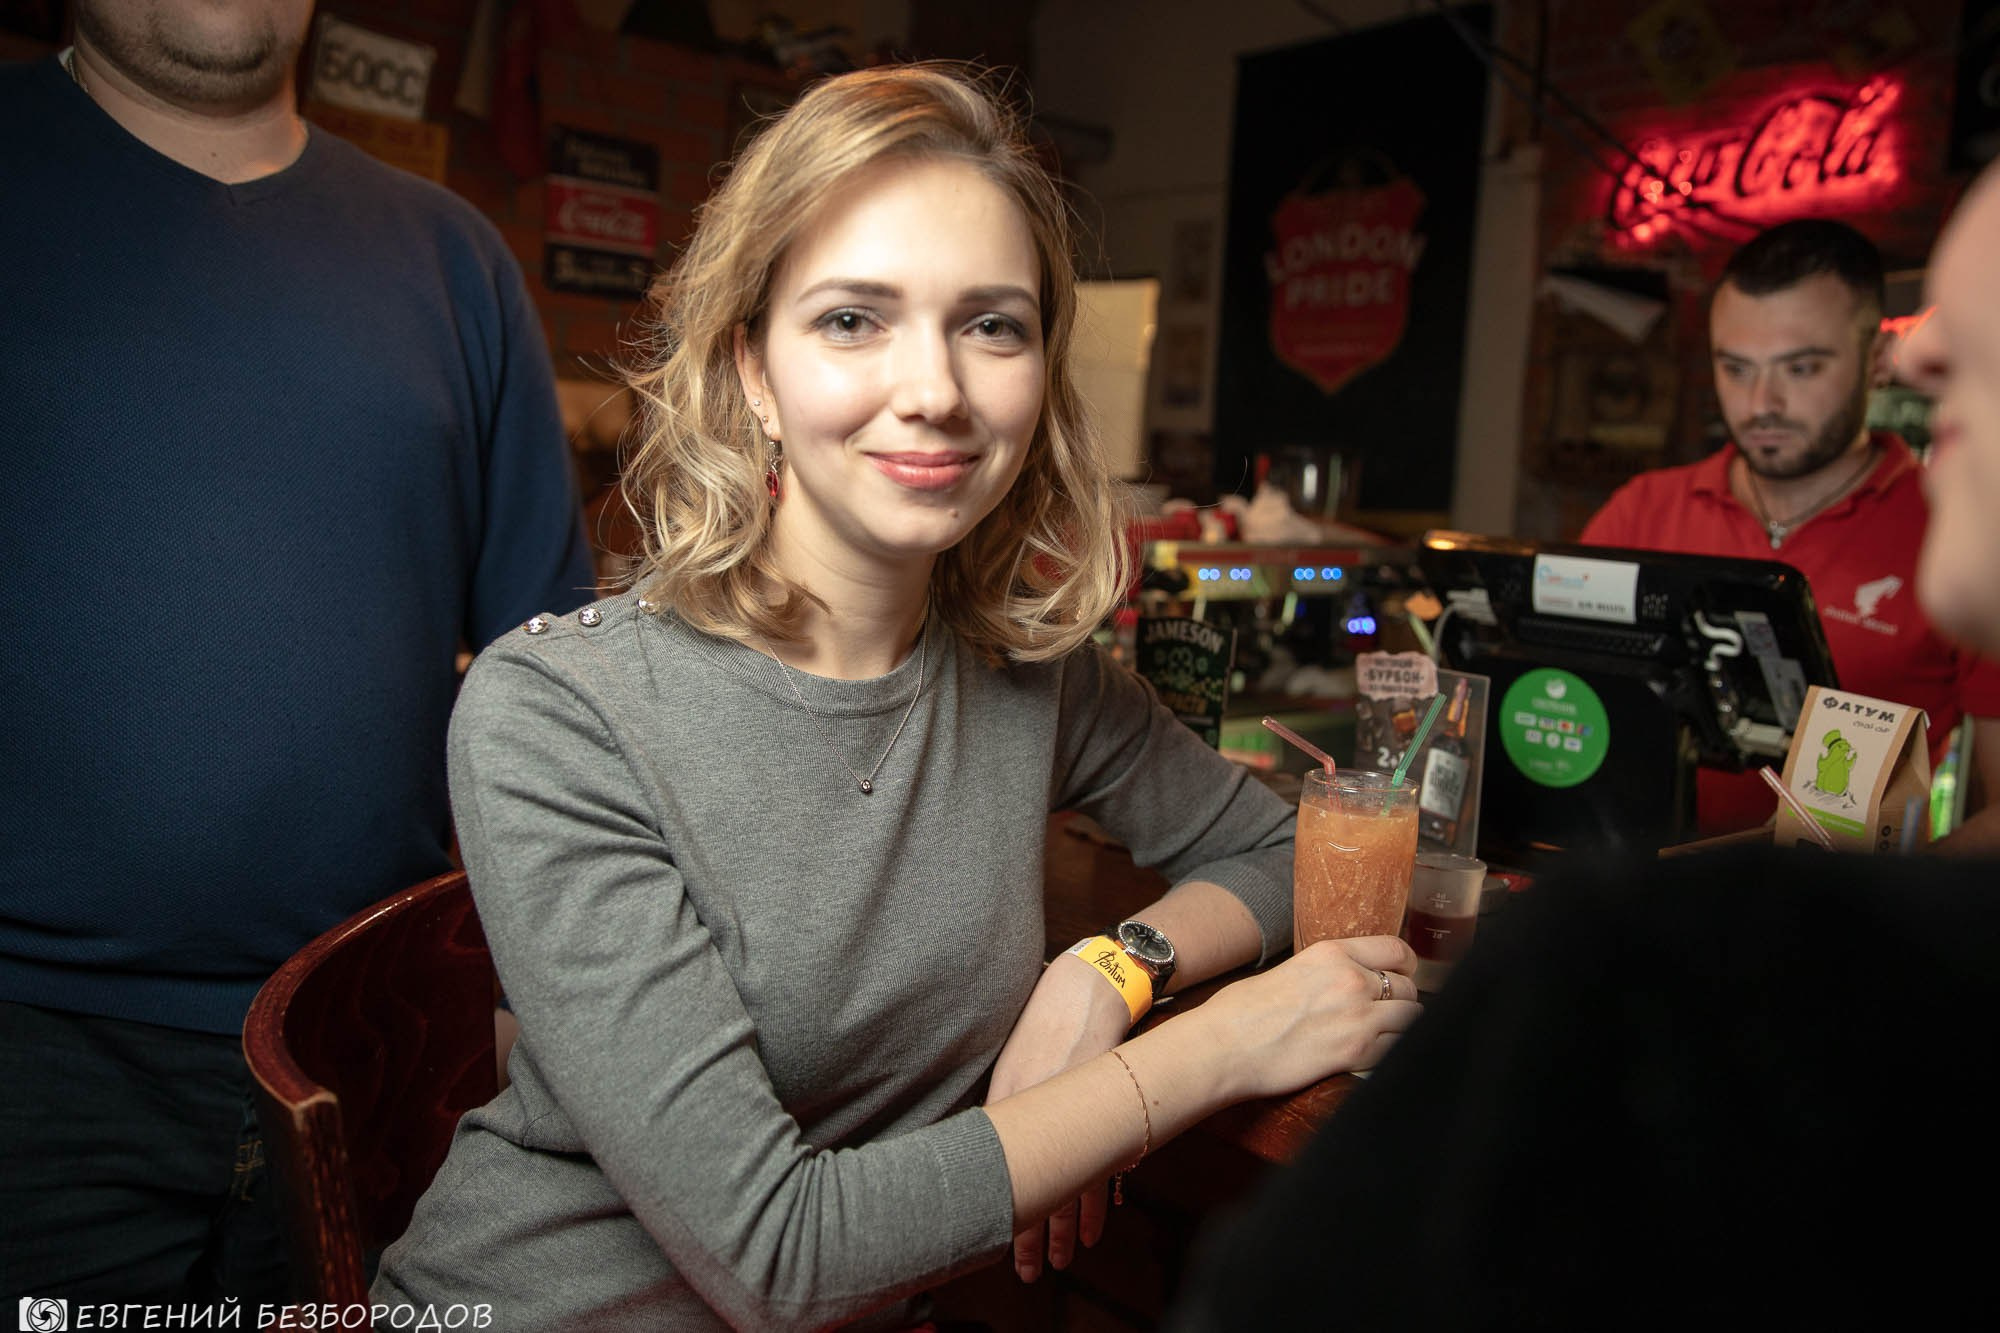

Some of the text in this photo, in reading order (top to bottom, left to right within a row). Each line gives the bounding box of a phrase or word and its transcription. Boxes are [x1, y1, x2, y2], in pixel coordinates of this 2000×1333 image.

[1261, 221, 1428, 286] LONDON
[1283, 268, 1395, 311] PRIDE
[1145, 620, 1224, 655] JAMESON
[1823, 697, 1895, 723] ФАТУМ
